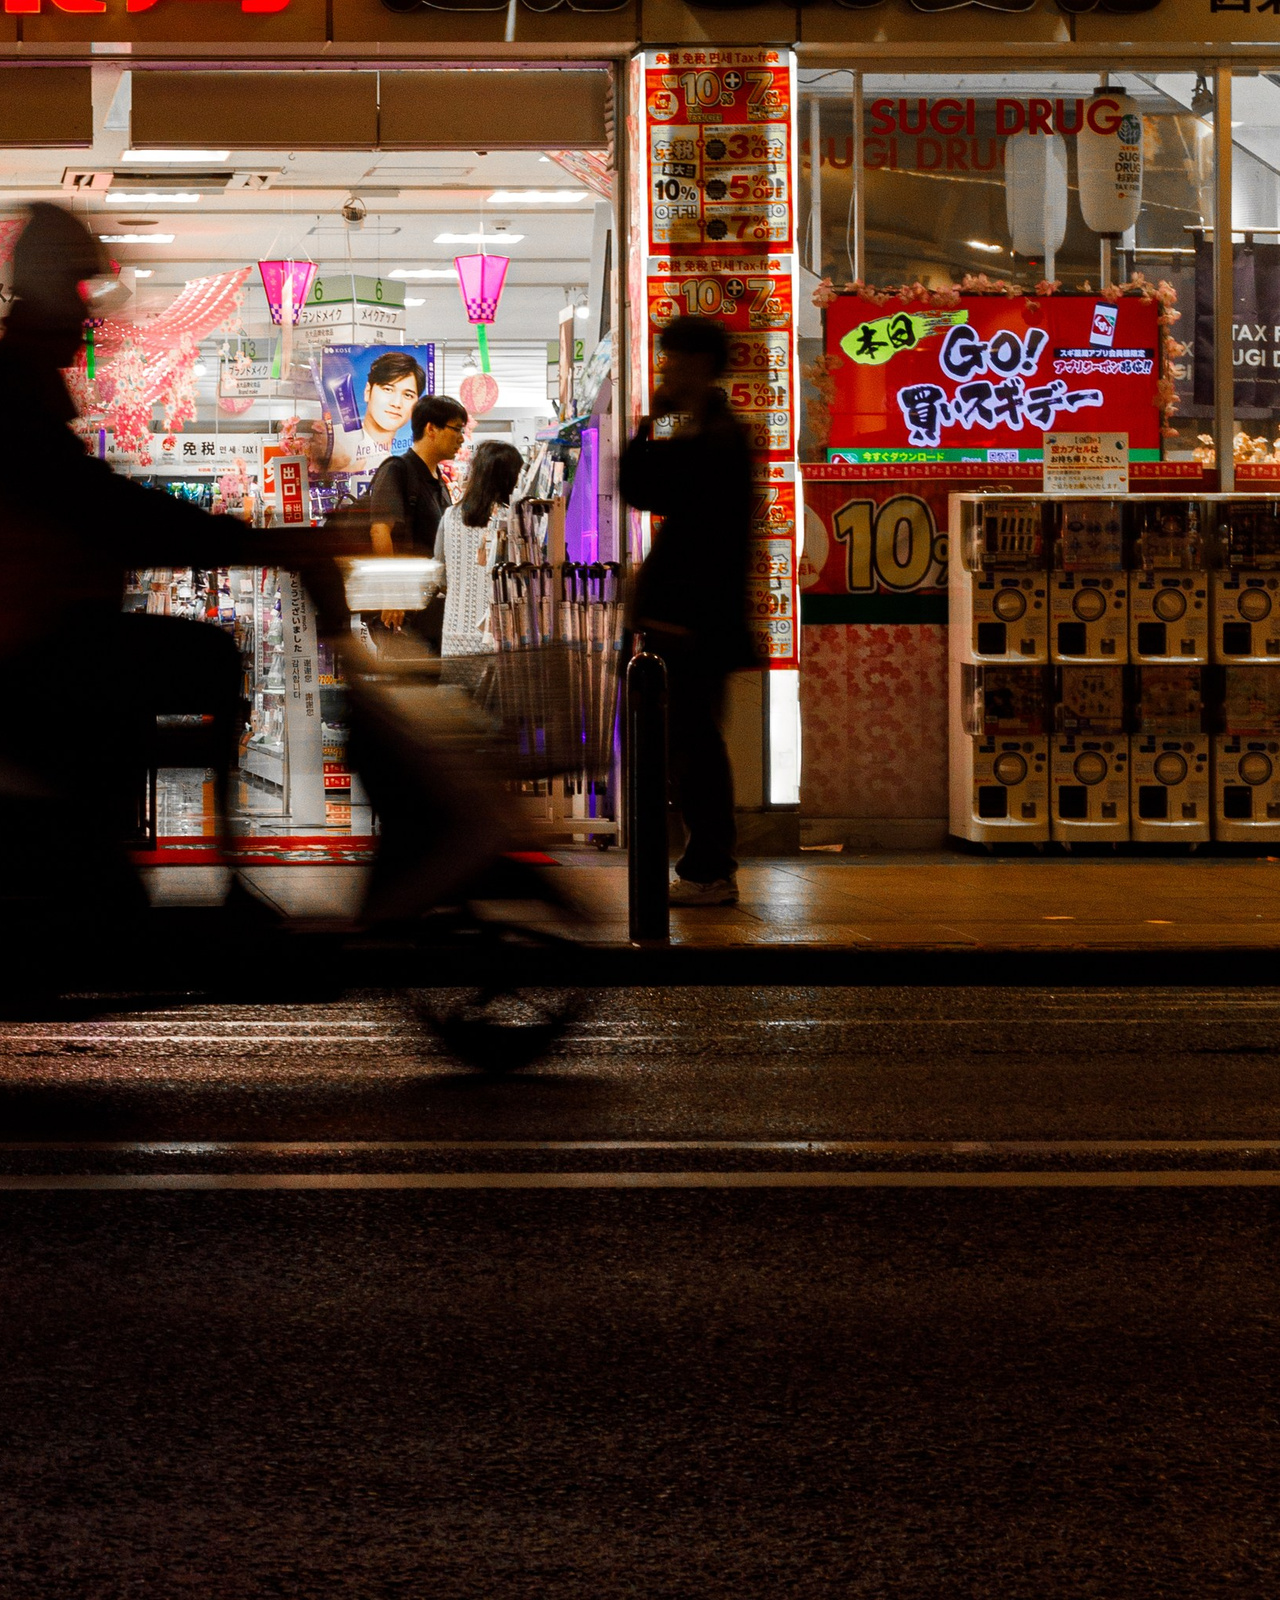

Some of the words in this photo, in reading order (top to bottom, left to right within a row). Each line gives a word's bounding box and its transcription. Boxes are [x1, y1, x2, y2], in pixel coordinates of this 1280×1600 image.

[871, 98, 975, 136] SUGI
[996, 98, 1122, 136] DRUG
[918, 137, 1006, 171] DRU
[654, 179, 696, 201] 10%
[314, 282, 323, 300] 6
[375, 281, 383, 300] 6
[301, 309, 342, 323] ランドメイク
[362, 309, 397, 323] メイクアップ
[855, 314, 915, 360] 本日
[941, 325, 1047, 380] GO!
[1232, 348, 1266, 367] UGI
[900, 378, 1101, 444] 買いスギデー
[183, 441, 215, 455] 免税
[242, 445, 253, 454] TAX
[356, 445, 370, 456] Are
[373, 441, 389, 453] You
[391, 436, 413, 449] Read
[862, 451, 945, 462] 今すぐダウンロード
[283, 467, 296, 496] 出口
[289, 572, 302, 653] がとうございました
